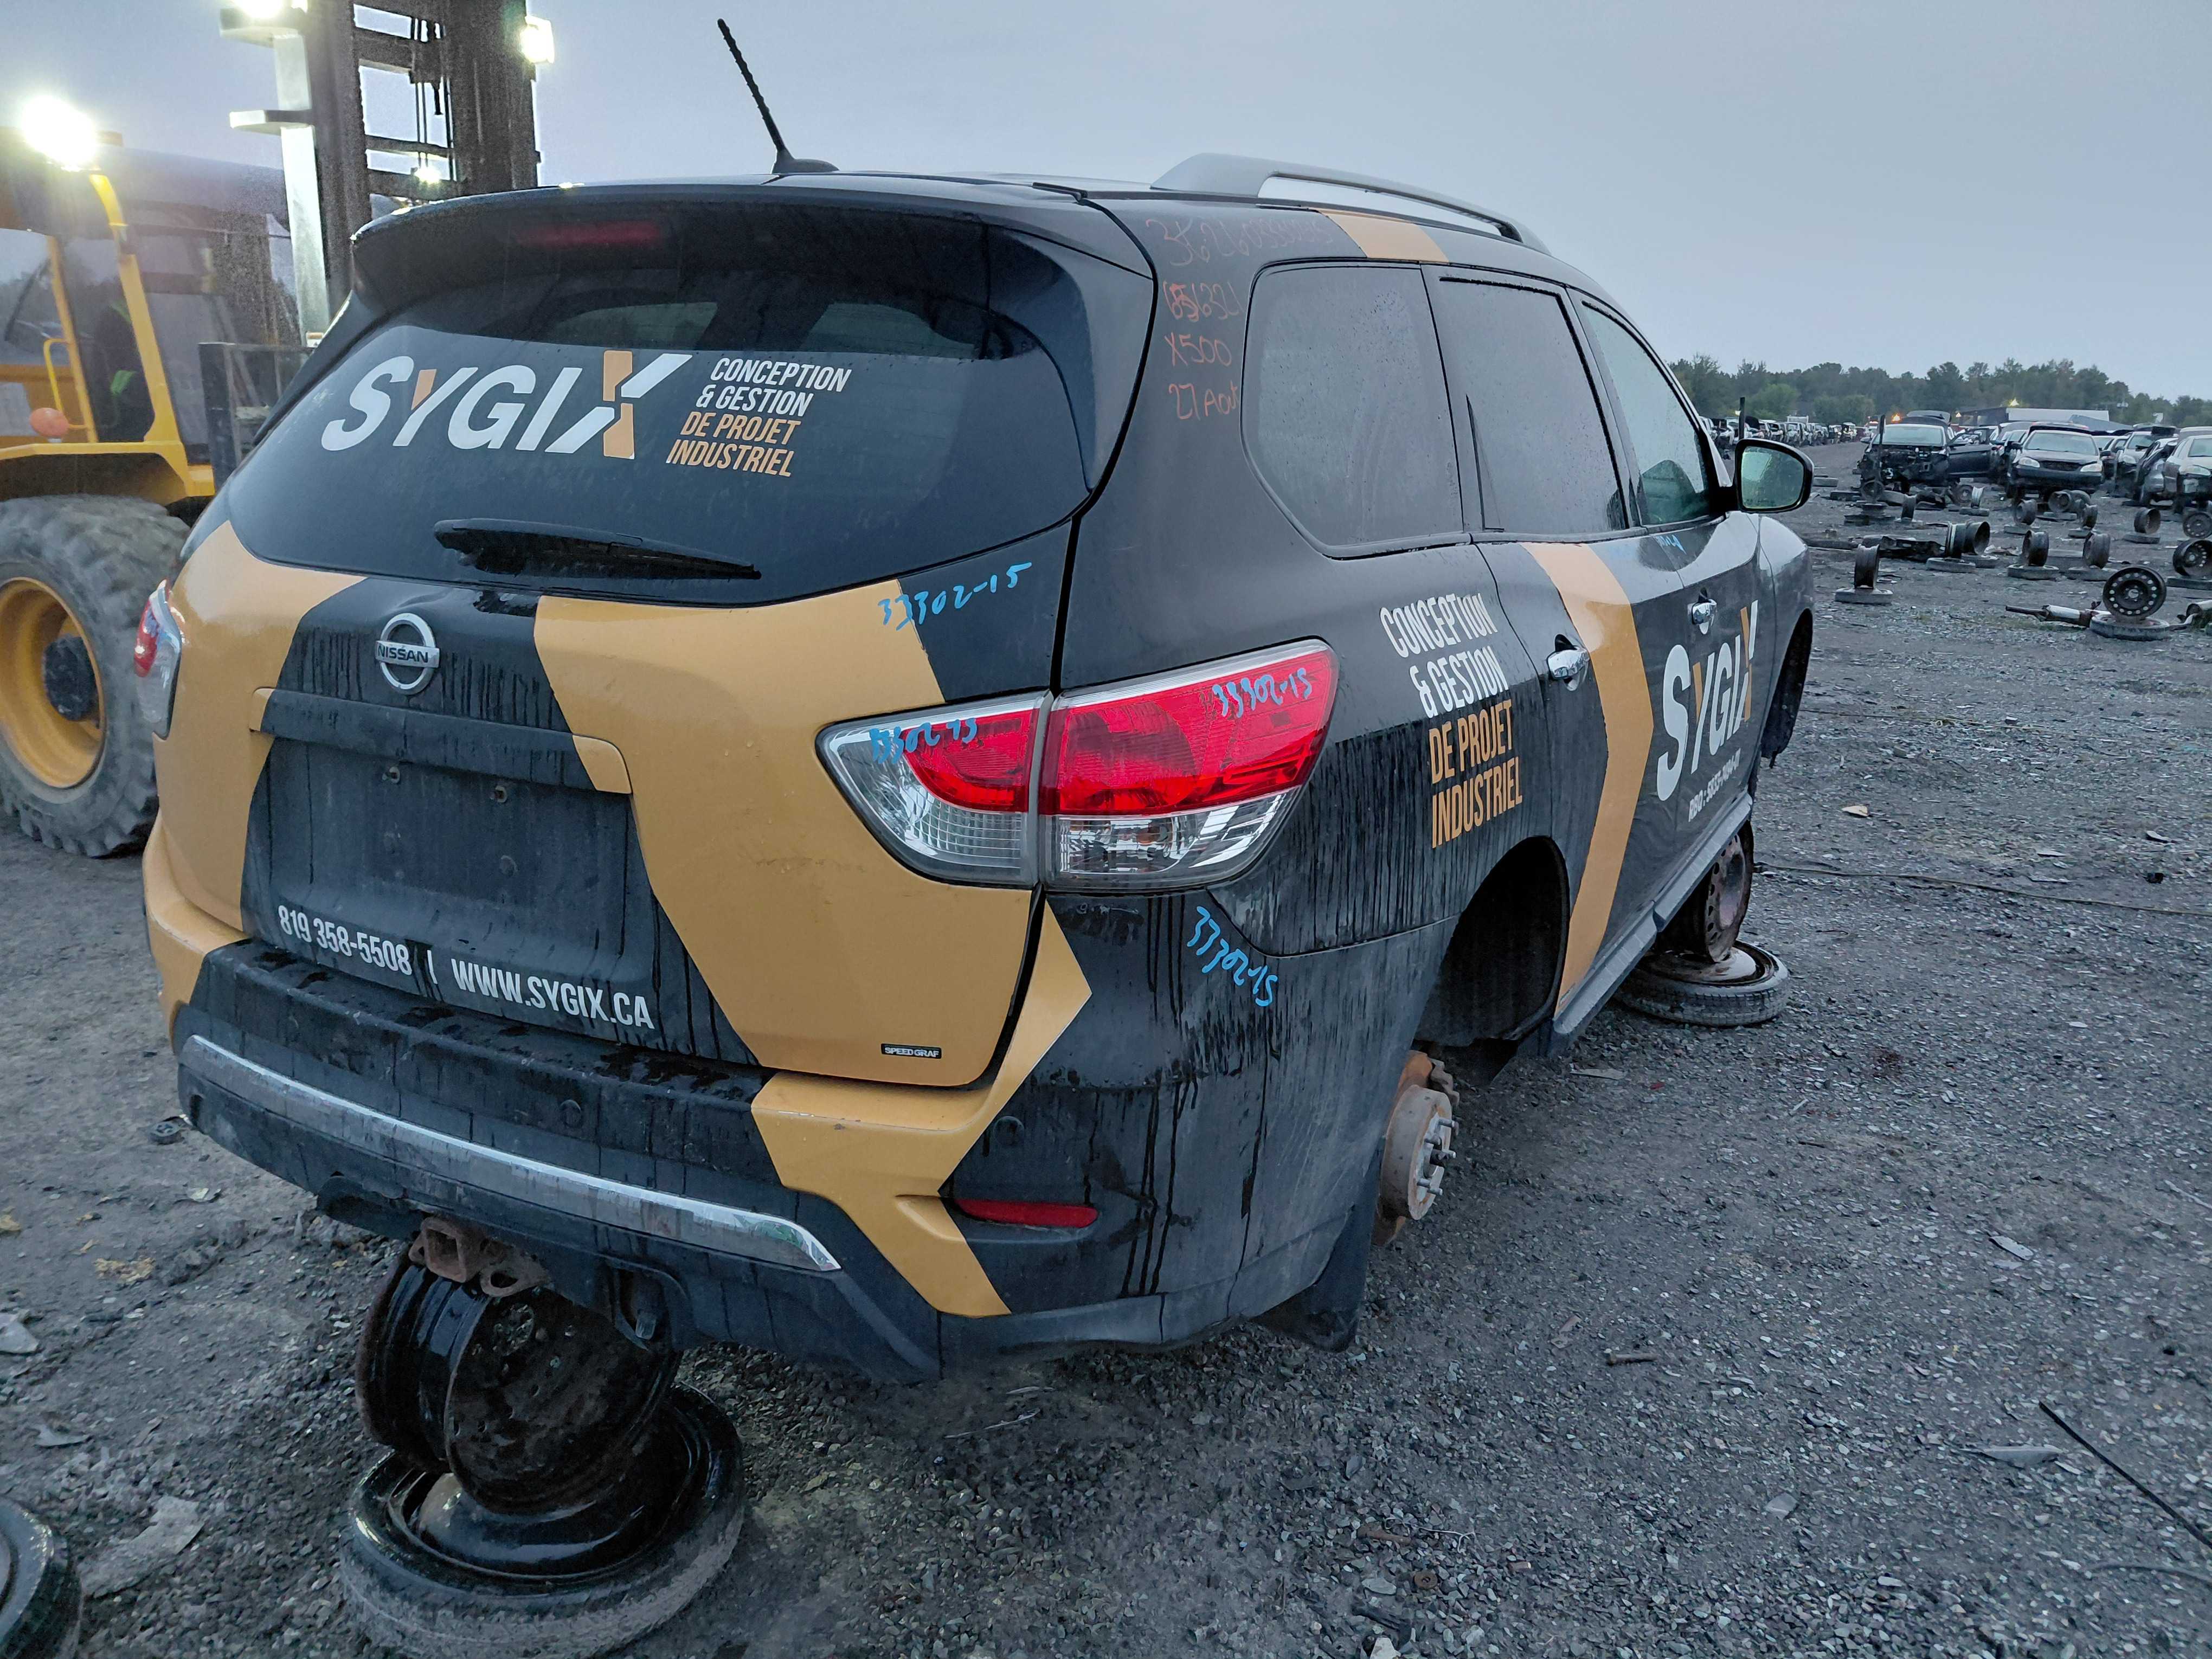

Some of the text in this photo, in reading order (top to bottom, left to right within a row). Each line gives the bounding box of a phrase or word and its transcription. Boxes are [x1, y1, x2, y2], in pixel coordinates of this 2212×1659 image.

[321, 350, 692, 460] SYGIX
[697, 387, 813, 418] & GESTION
[710, 357, 852, 393] CONCEPTION
[666, 439, 795, 477] INDUSTRIEL
[681, 412, 801, 443] DE PROJET
[377, 645, 428, 663] NISSAN
[1380, 593, 1498, 658] CONCEPTION
[1410, 645, 1509, 718] & GESTION
[1429, 699, 1512, 784] DE PROJET
[1432, 756, 1523, 848] INDUSTRIEL
[278, 905, 655, 1030] 819 358-5508 WWW.SYGIX.CA
